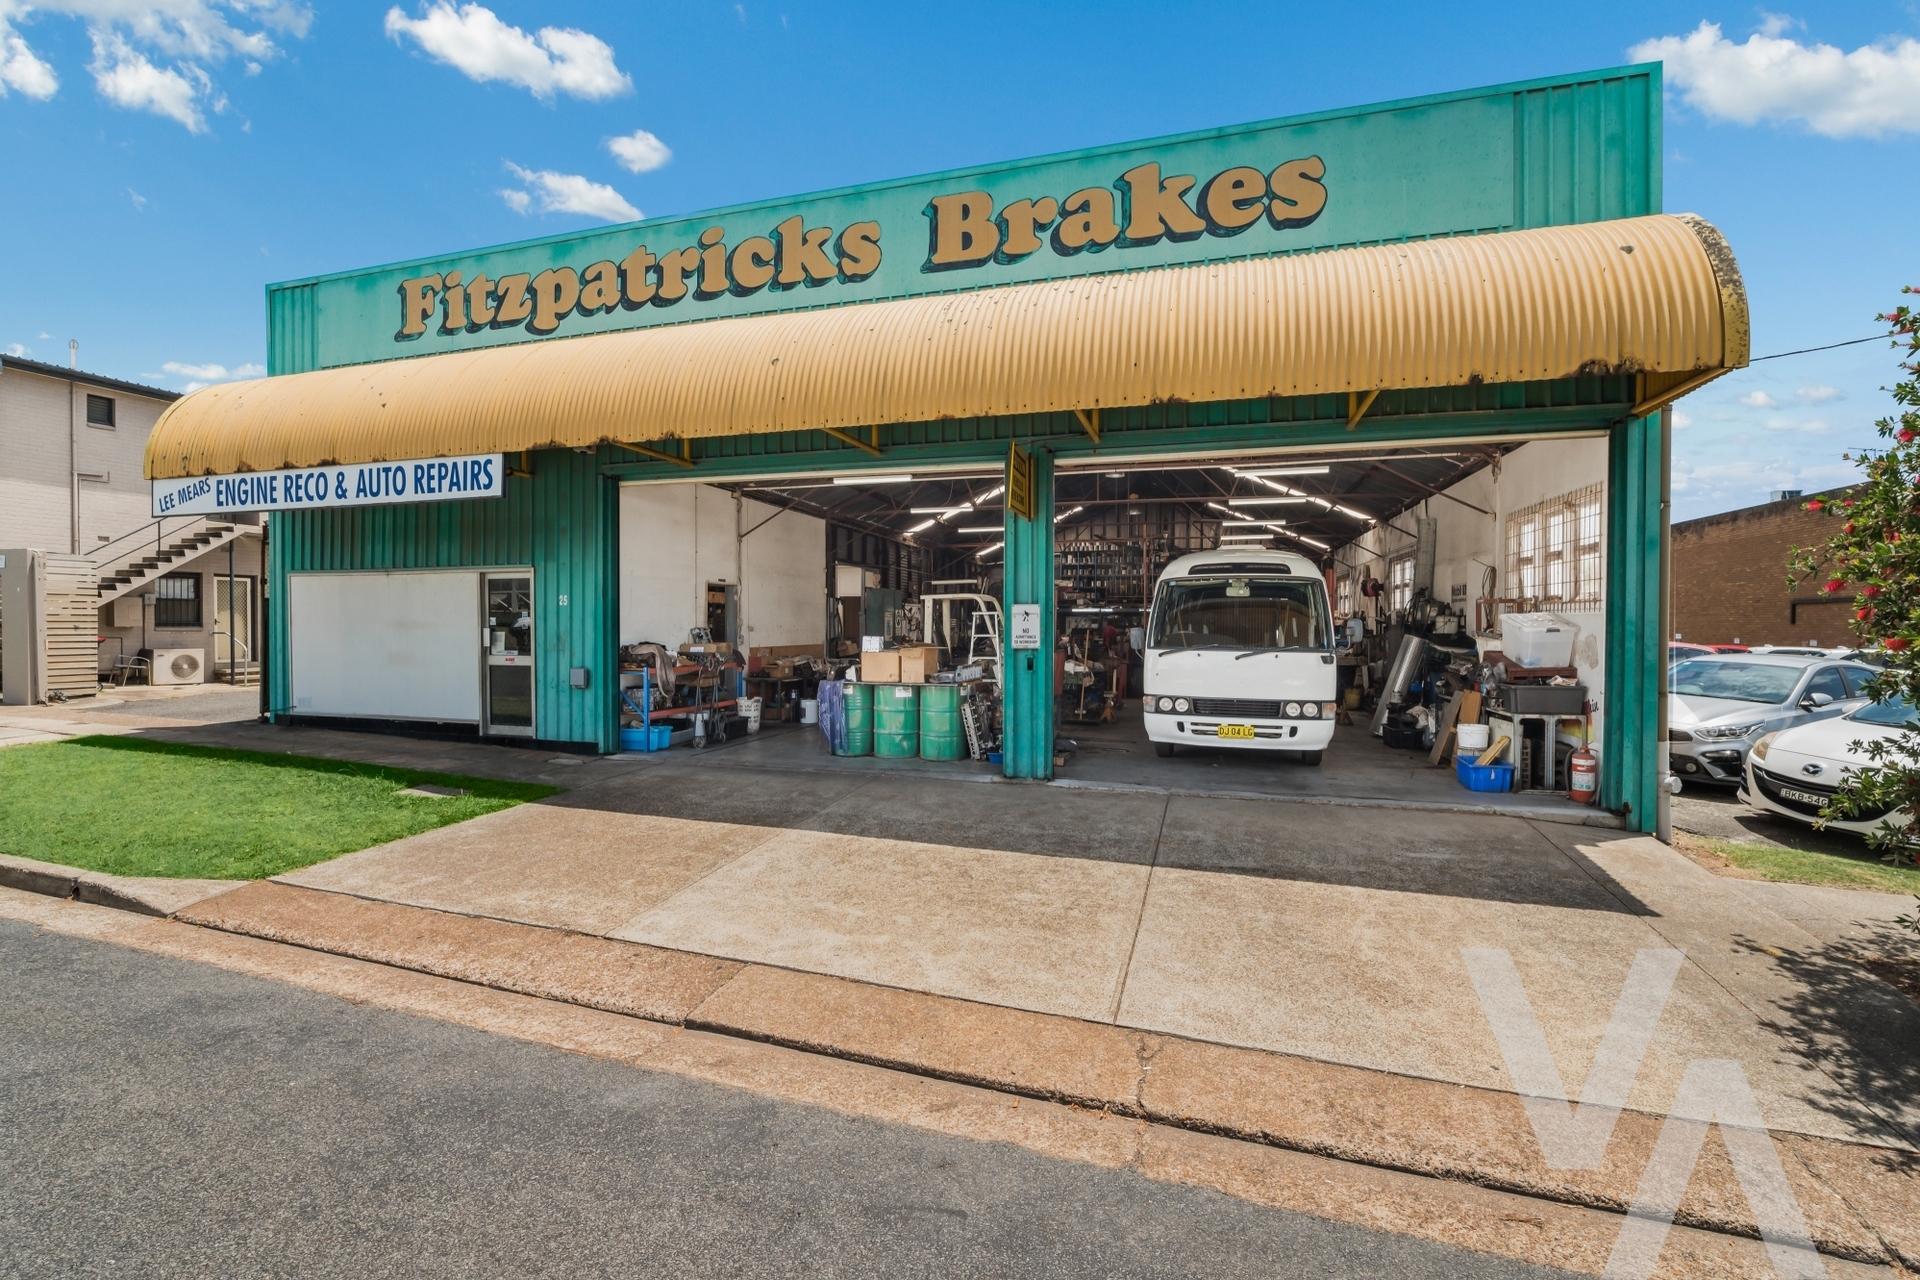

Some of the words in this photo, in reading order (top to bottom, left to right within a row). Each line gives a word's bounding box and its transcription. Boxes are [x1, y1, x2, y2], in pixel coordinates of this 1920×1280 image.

[394, 215, 883, 342] Fitzpatricks
[921, 155, 1327, 273] Brakes
[158, 492, 175, 512] LEE
[177, 477, 212, 505] MEARS
[216, 475, 278, 507] ENGINE
[284, 471, 328, 503] RECO
[335, 471, 348, 500] &
[356, 465, 407, 498] AUTO
[414, 458, 493, 494] REPAIRS
[559, 594, 568, 606] 25
